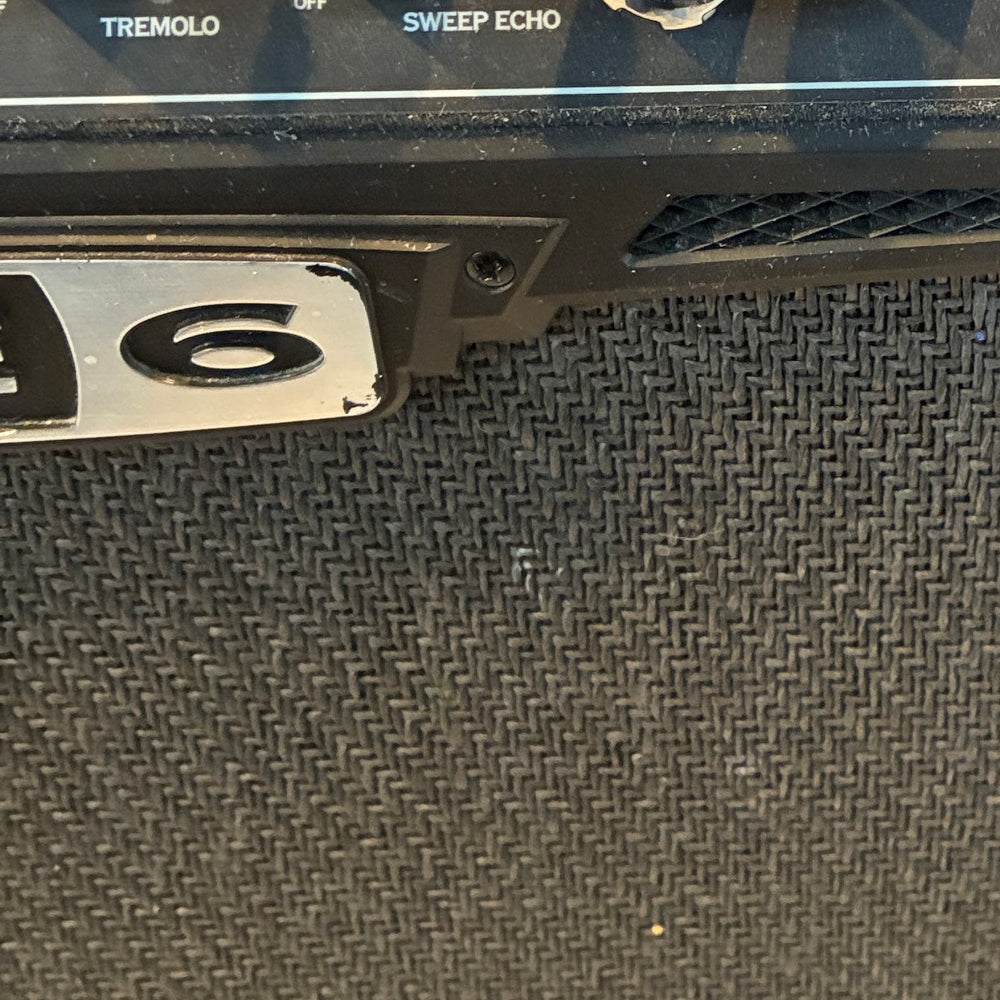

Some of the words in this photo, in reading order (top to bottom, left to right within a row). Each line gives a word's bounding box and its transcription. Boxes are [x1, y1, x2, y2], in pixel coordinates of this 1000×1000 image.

[100, 15, 220, 38] TREMOLO
[403, 10, 489, 33] SWEEP
[494, 9, 561, 31] ECHO
[119, 303, 325, 387] 6
